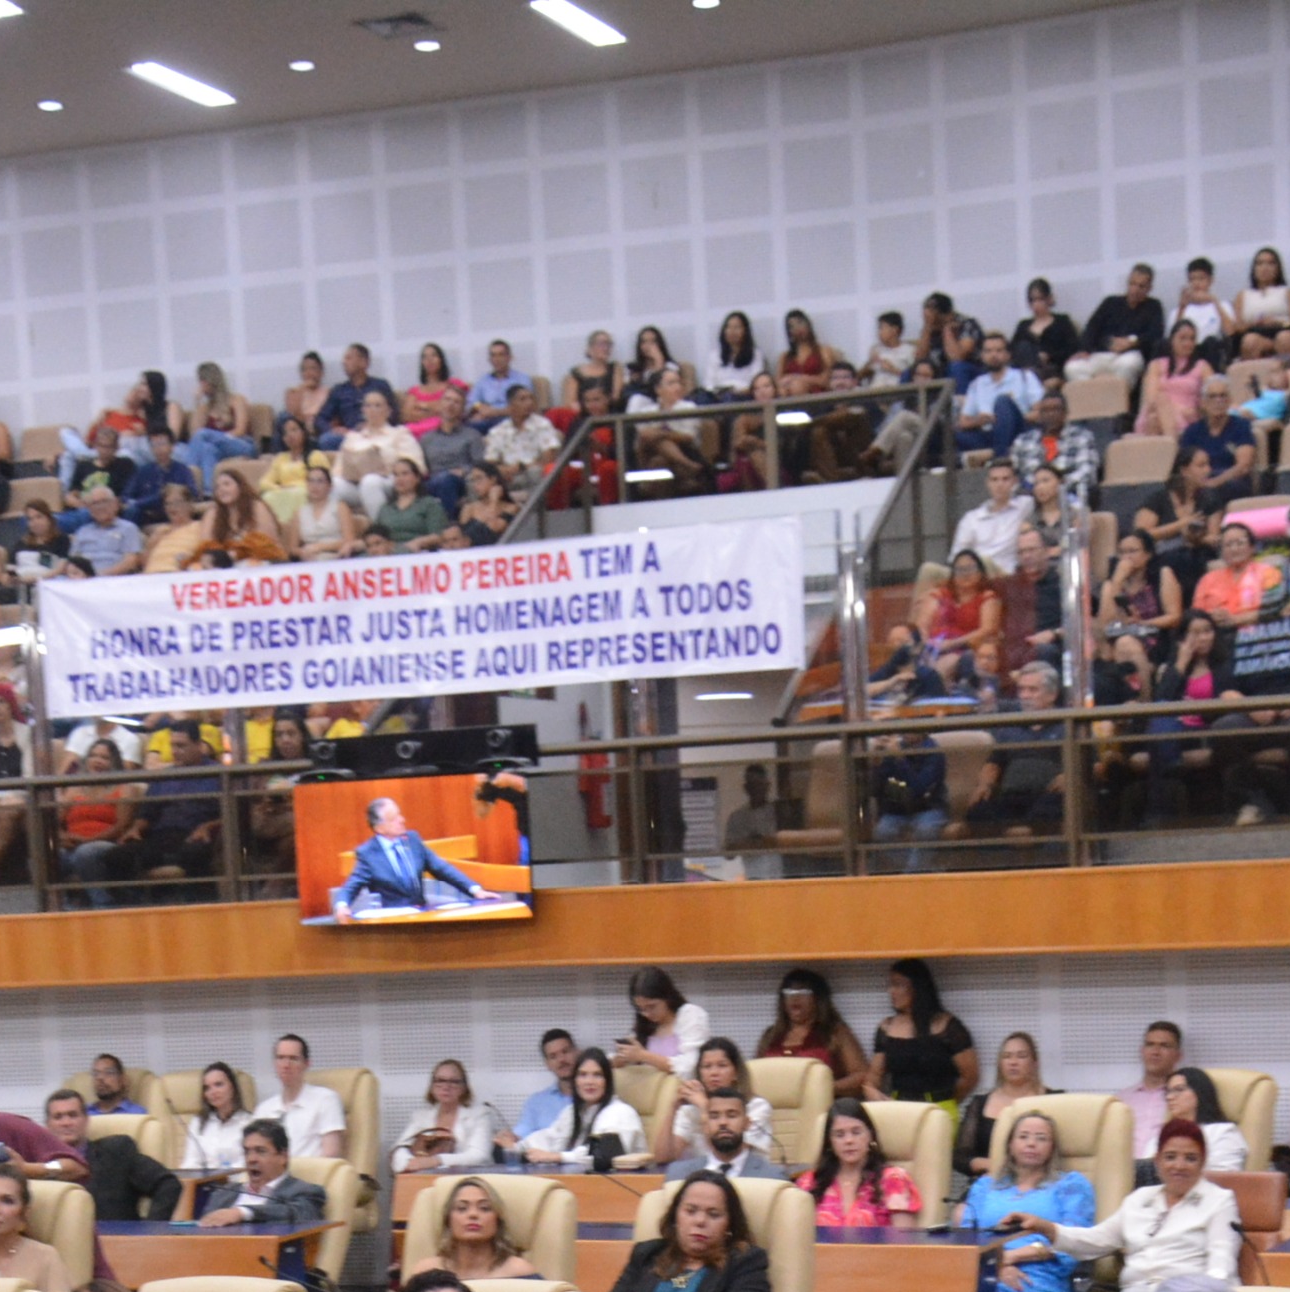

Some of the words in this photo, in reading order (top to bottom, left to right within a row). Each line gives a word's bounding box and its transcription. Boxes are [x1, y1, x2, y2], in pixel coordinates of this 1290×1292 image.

[171, 574, 314, 611] VEREADOR
[324, 563, 451, 600] ANSELMO
[461, 551, 572, 590] PEREIRA
[580, 544, 633, 578] TEM
[642, 542, 661, 572] A
[91, 625, 181, 659] HONRA
[190, 622, 223, 653] DE
[232, 614, 352, 650] PRESTAR
[361, 608, 446, 642] JUSTA
[455, 590, 623, 635] HOMENAGEM
[631, 588, 650, 618] A
[660, 579, 752, 617] TODOS
[68, 661, 292, 702] TRABALHADORES
[303, 649, 465, 689] GOIANIENSE
[474, 643, 536, 678] AQUI
[548, 623, 781, 671] REPRESENTANDO
